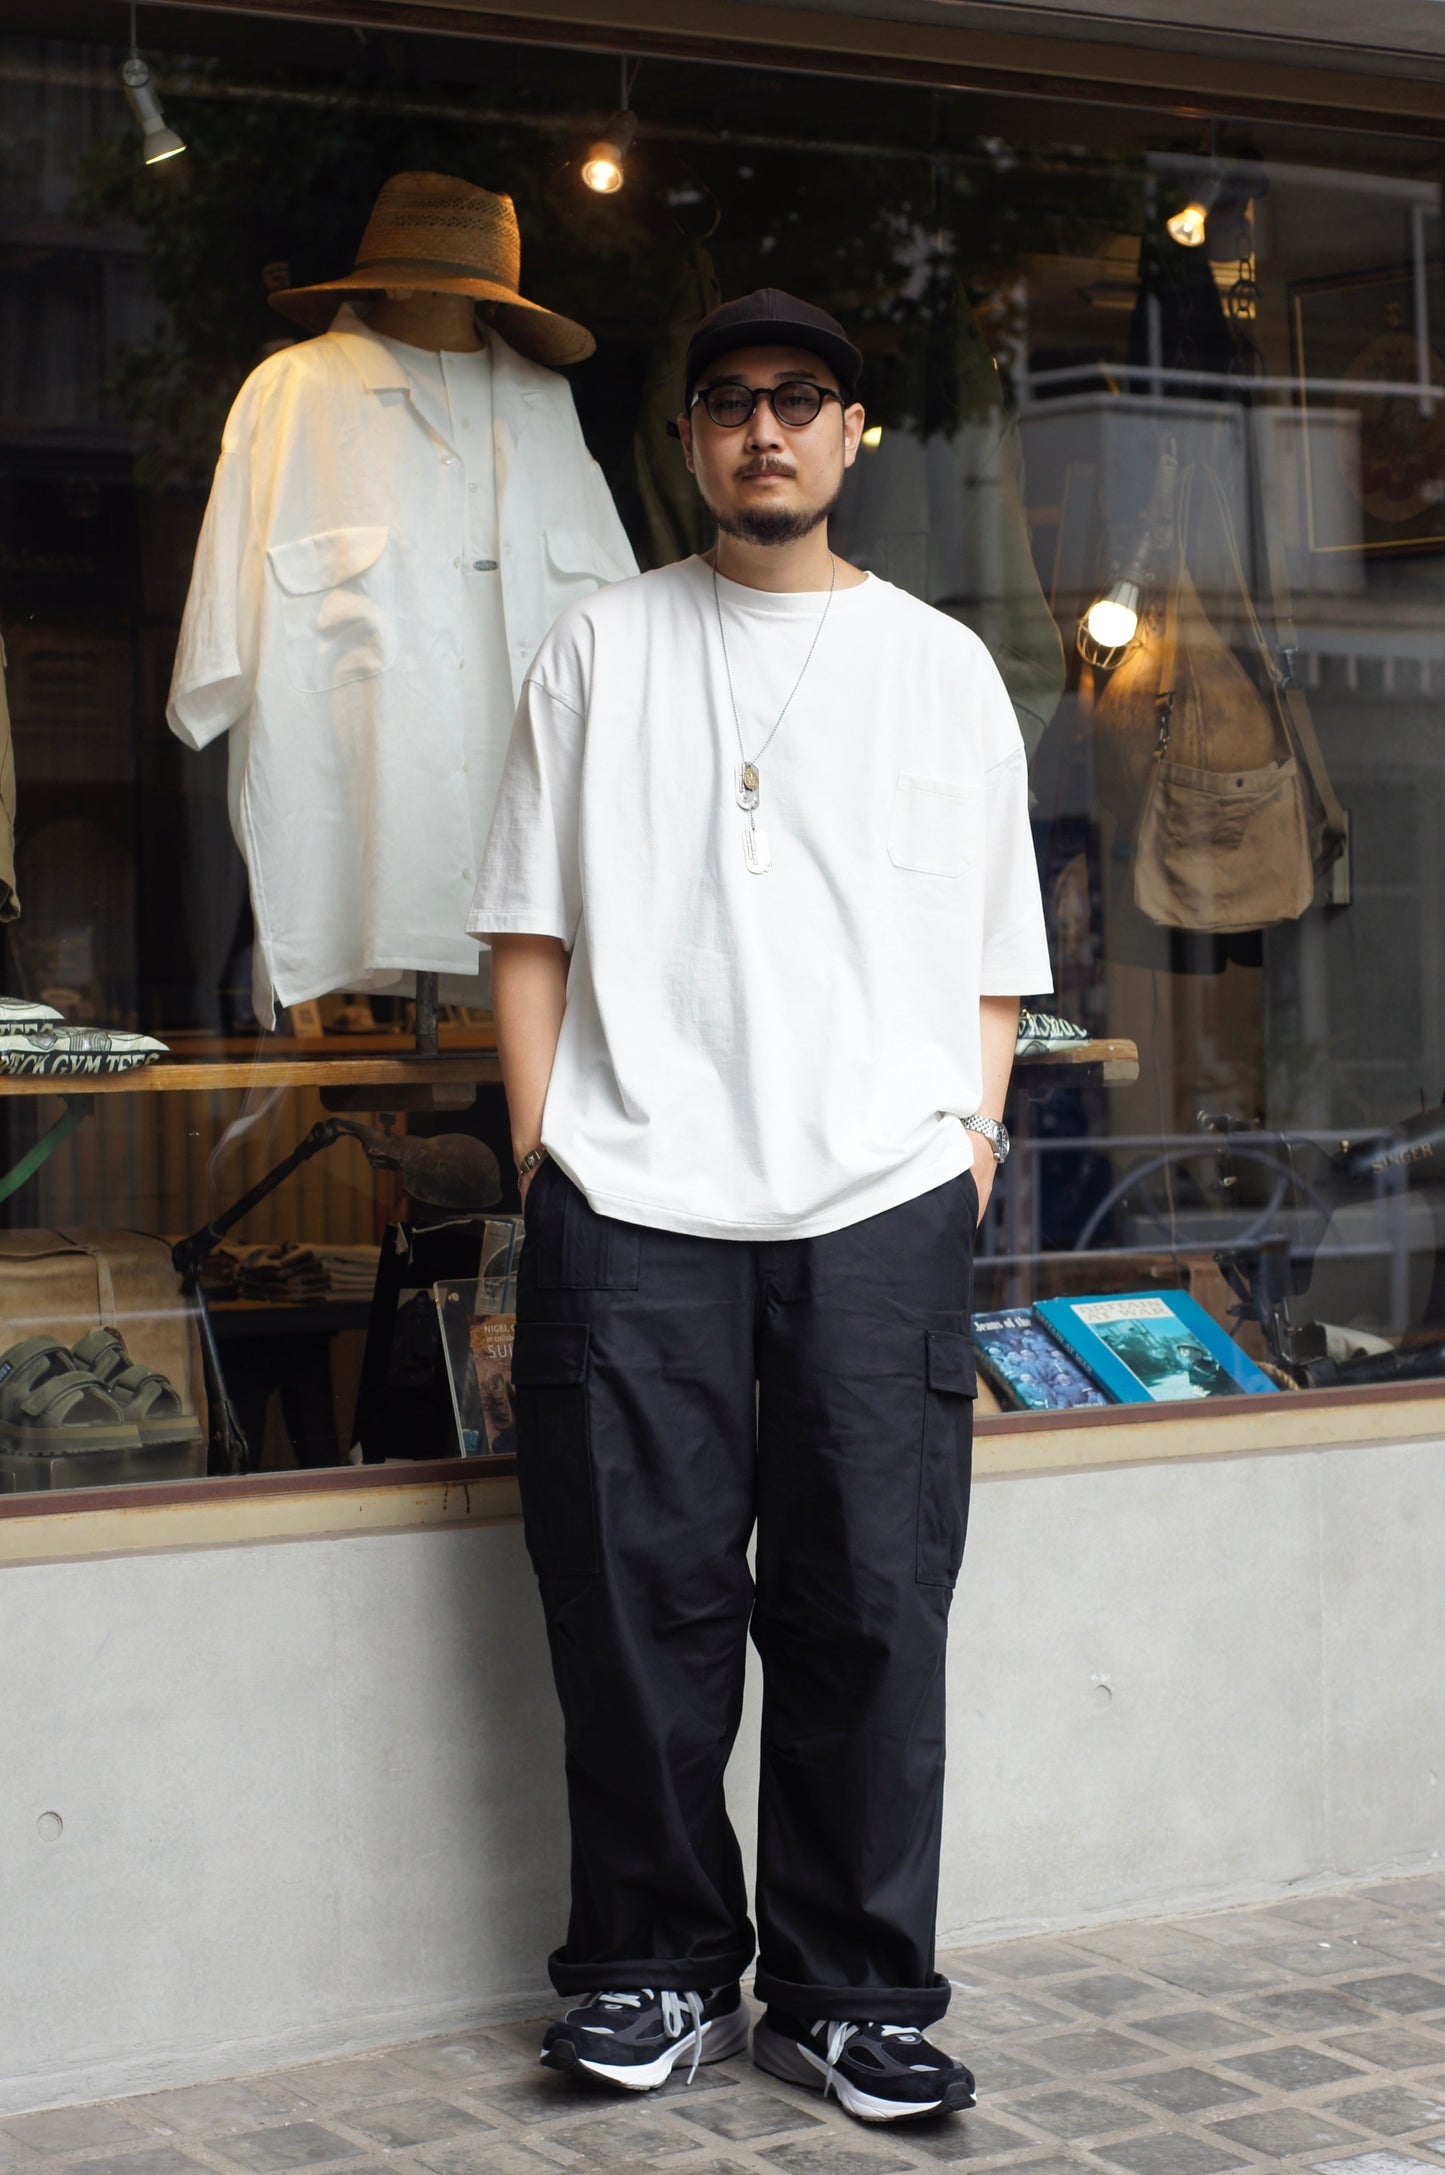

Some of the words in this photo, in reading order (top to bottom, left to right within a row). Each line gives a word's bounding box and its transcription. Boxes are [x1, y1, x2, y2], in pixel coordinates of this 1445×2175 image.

[50, 1054, 102, 1076] GYM
[1371, 1142, 1435, 1175] SINGER
[1078, 1300, 1162, 1314] BRITAIN
[1088, 1312, 1110, 1321] AT
[1119, 1307, 1169, 1317] WAR
[484, 1324, 510, 1334] NIGEL
[973, 1320, 1004, 1333] Jeans
[1003, 1317, 1016, 1328] of
[1014, 1316, 1032, 1328] the
